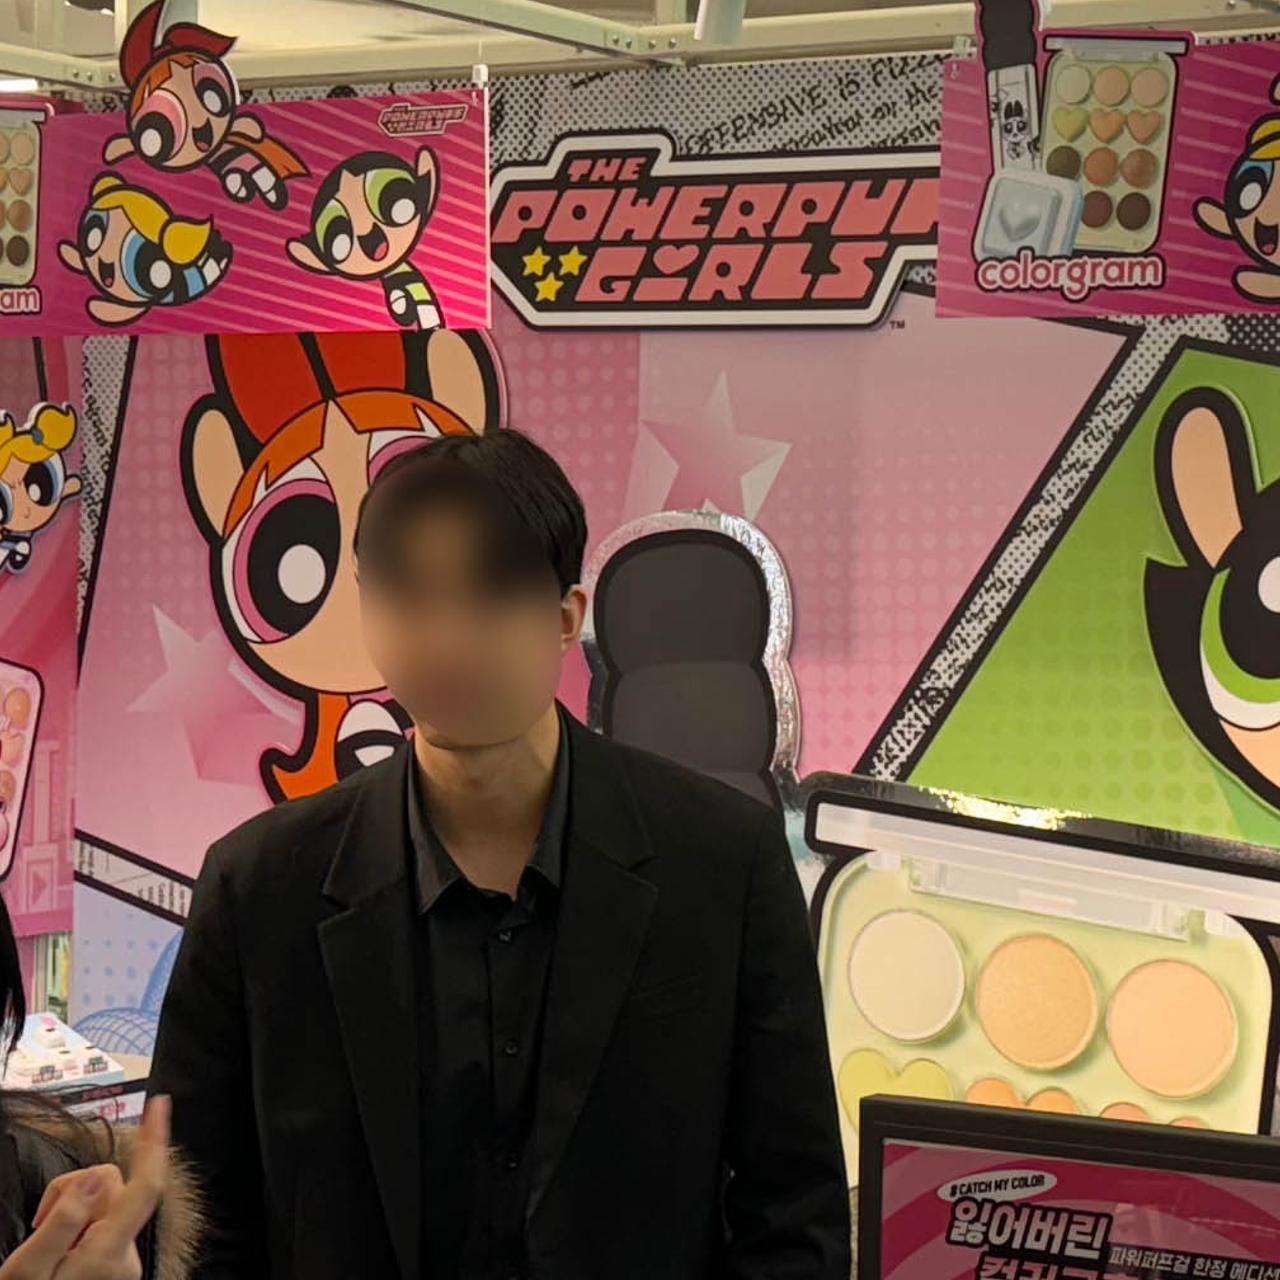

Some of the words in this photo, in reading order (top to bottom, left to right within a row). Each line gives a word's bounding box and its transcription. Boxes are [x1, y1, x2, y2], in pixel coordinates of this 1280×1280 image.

[567, 158, 646, 182] THE
[491, 177, 939, 242] POWERPUF
[574, 242, 888, 302] GIRLS
[977, 252, 1166, 300] colorgram
[959, 1179, 992, 1195] CATCH
[1012, 1174, 1045, 1190] COLOR
[950, 1199, 1110, 1260] 잃어버린
[1109, 1246, 1191, 1275] 파워퍼프걸
[1193, 1256, 1227, 1278] 한정
